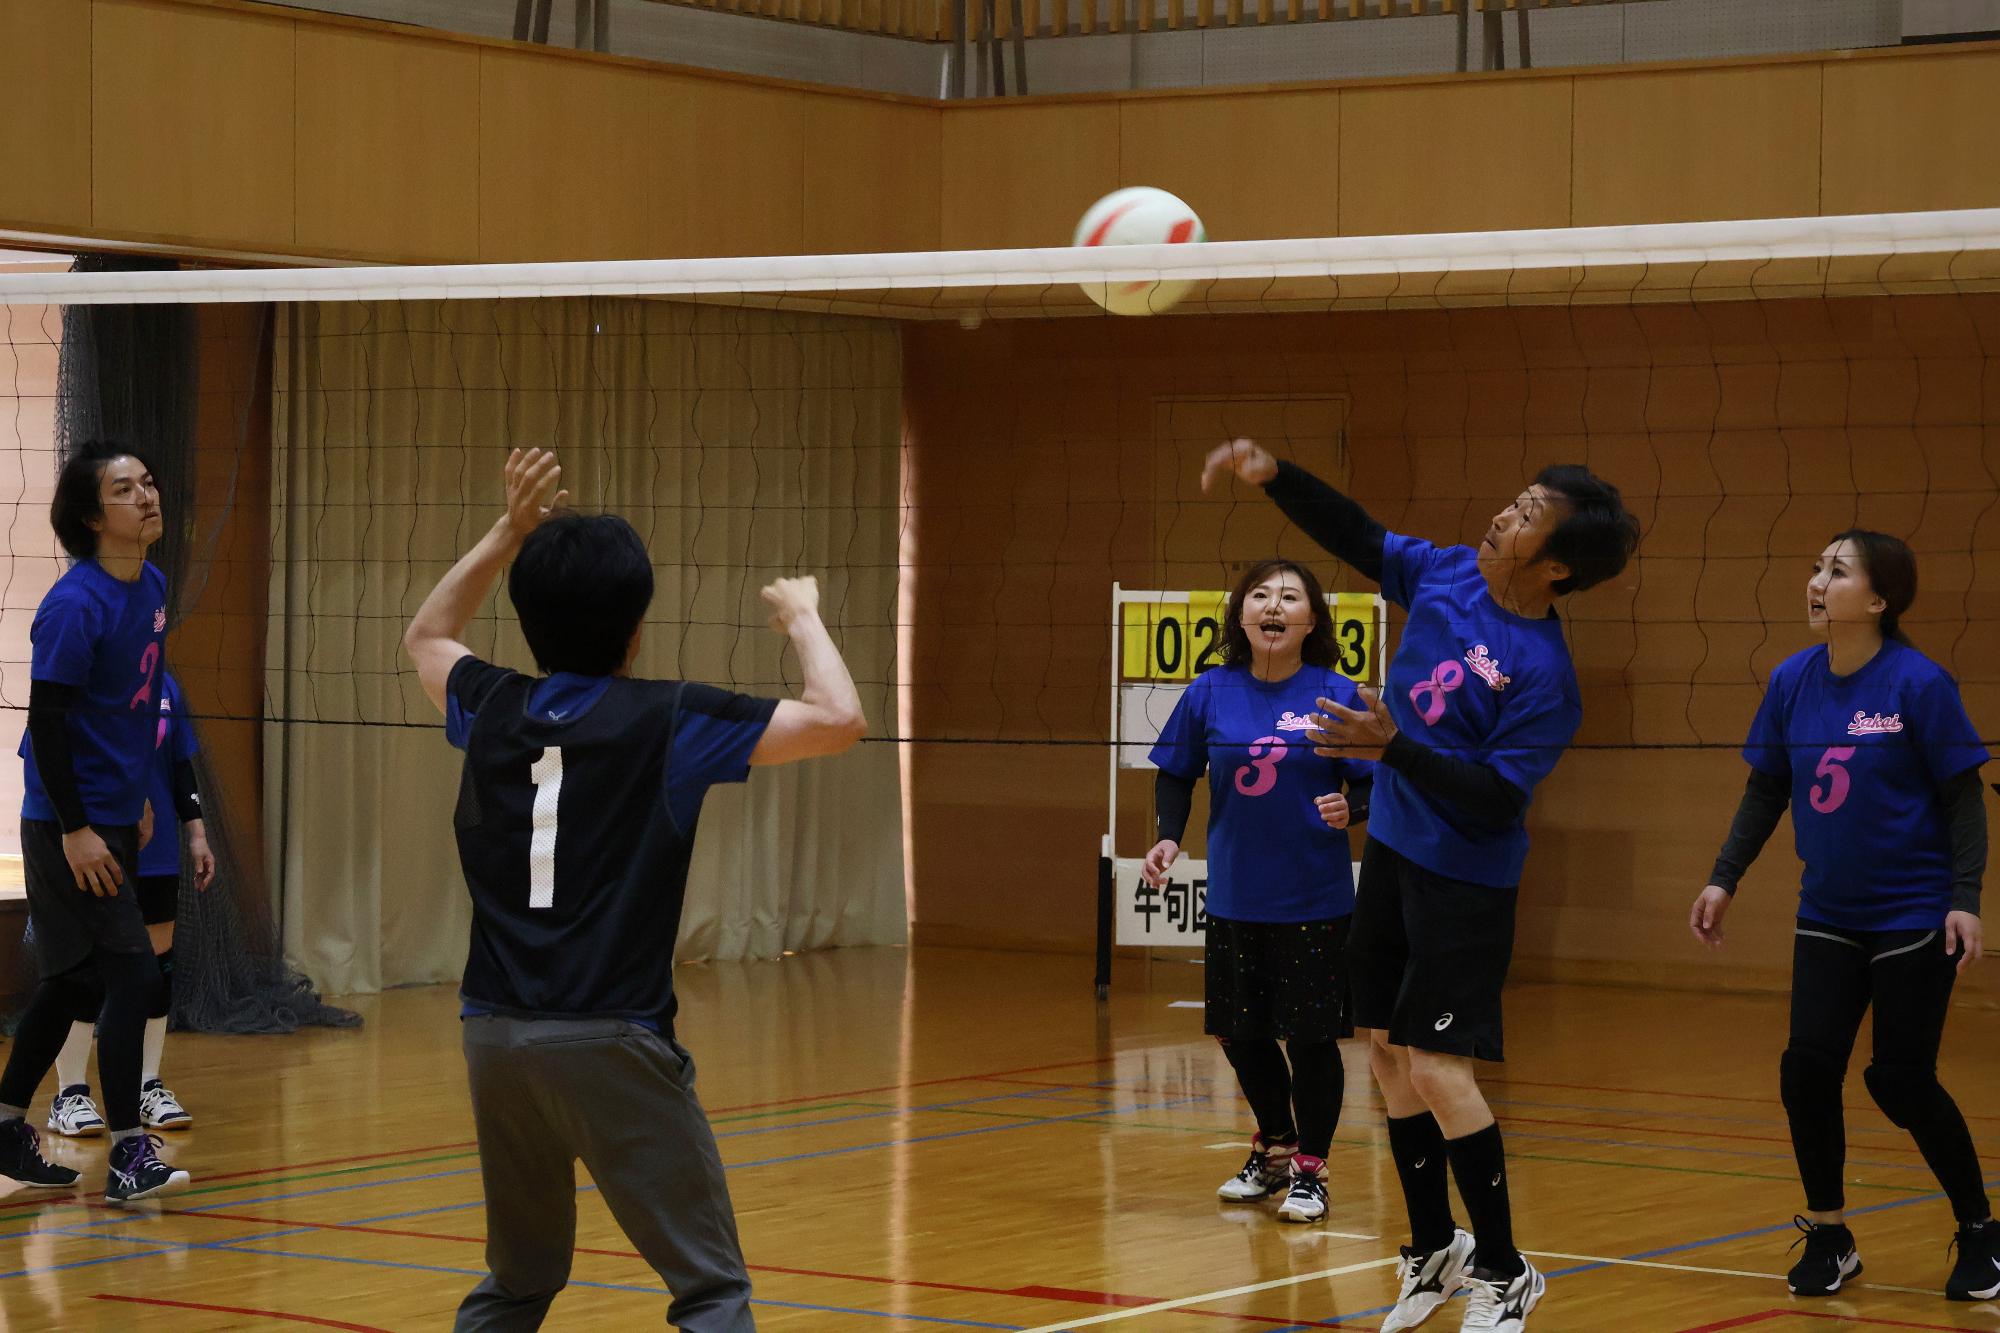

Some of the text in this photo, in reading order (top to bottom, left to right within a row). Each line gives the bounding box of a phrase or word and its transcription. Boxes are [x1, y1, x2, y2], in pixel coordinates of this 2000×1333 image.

[1340, 619, 1365, 676] 3
[1465, 644, 1510, 691] Sakai
[1409, 660, 1464, 726] 8
[1848, 710, 1903, 734] Sakai
[1234, 736, 1288, 797] 3
[1809, 746, 1856, 814] 5
[529, 746, 563, 908] 1
